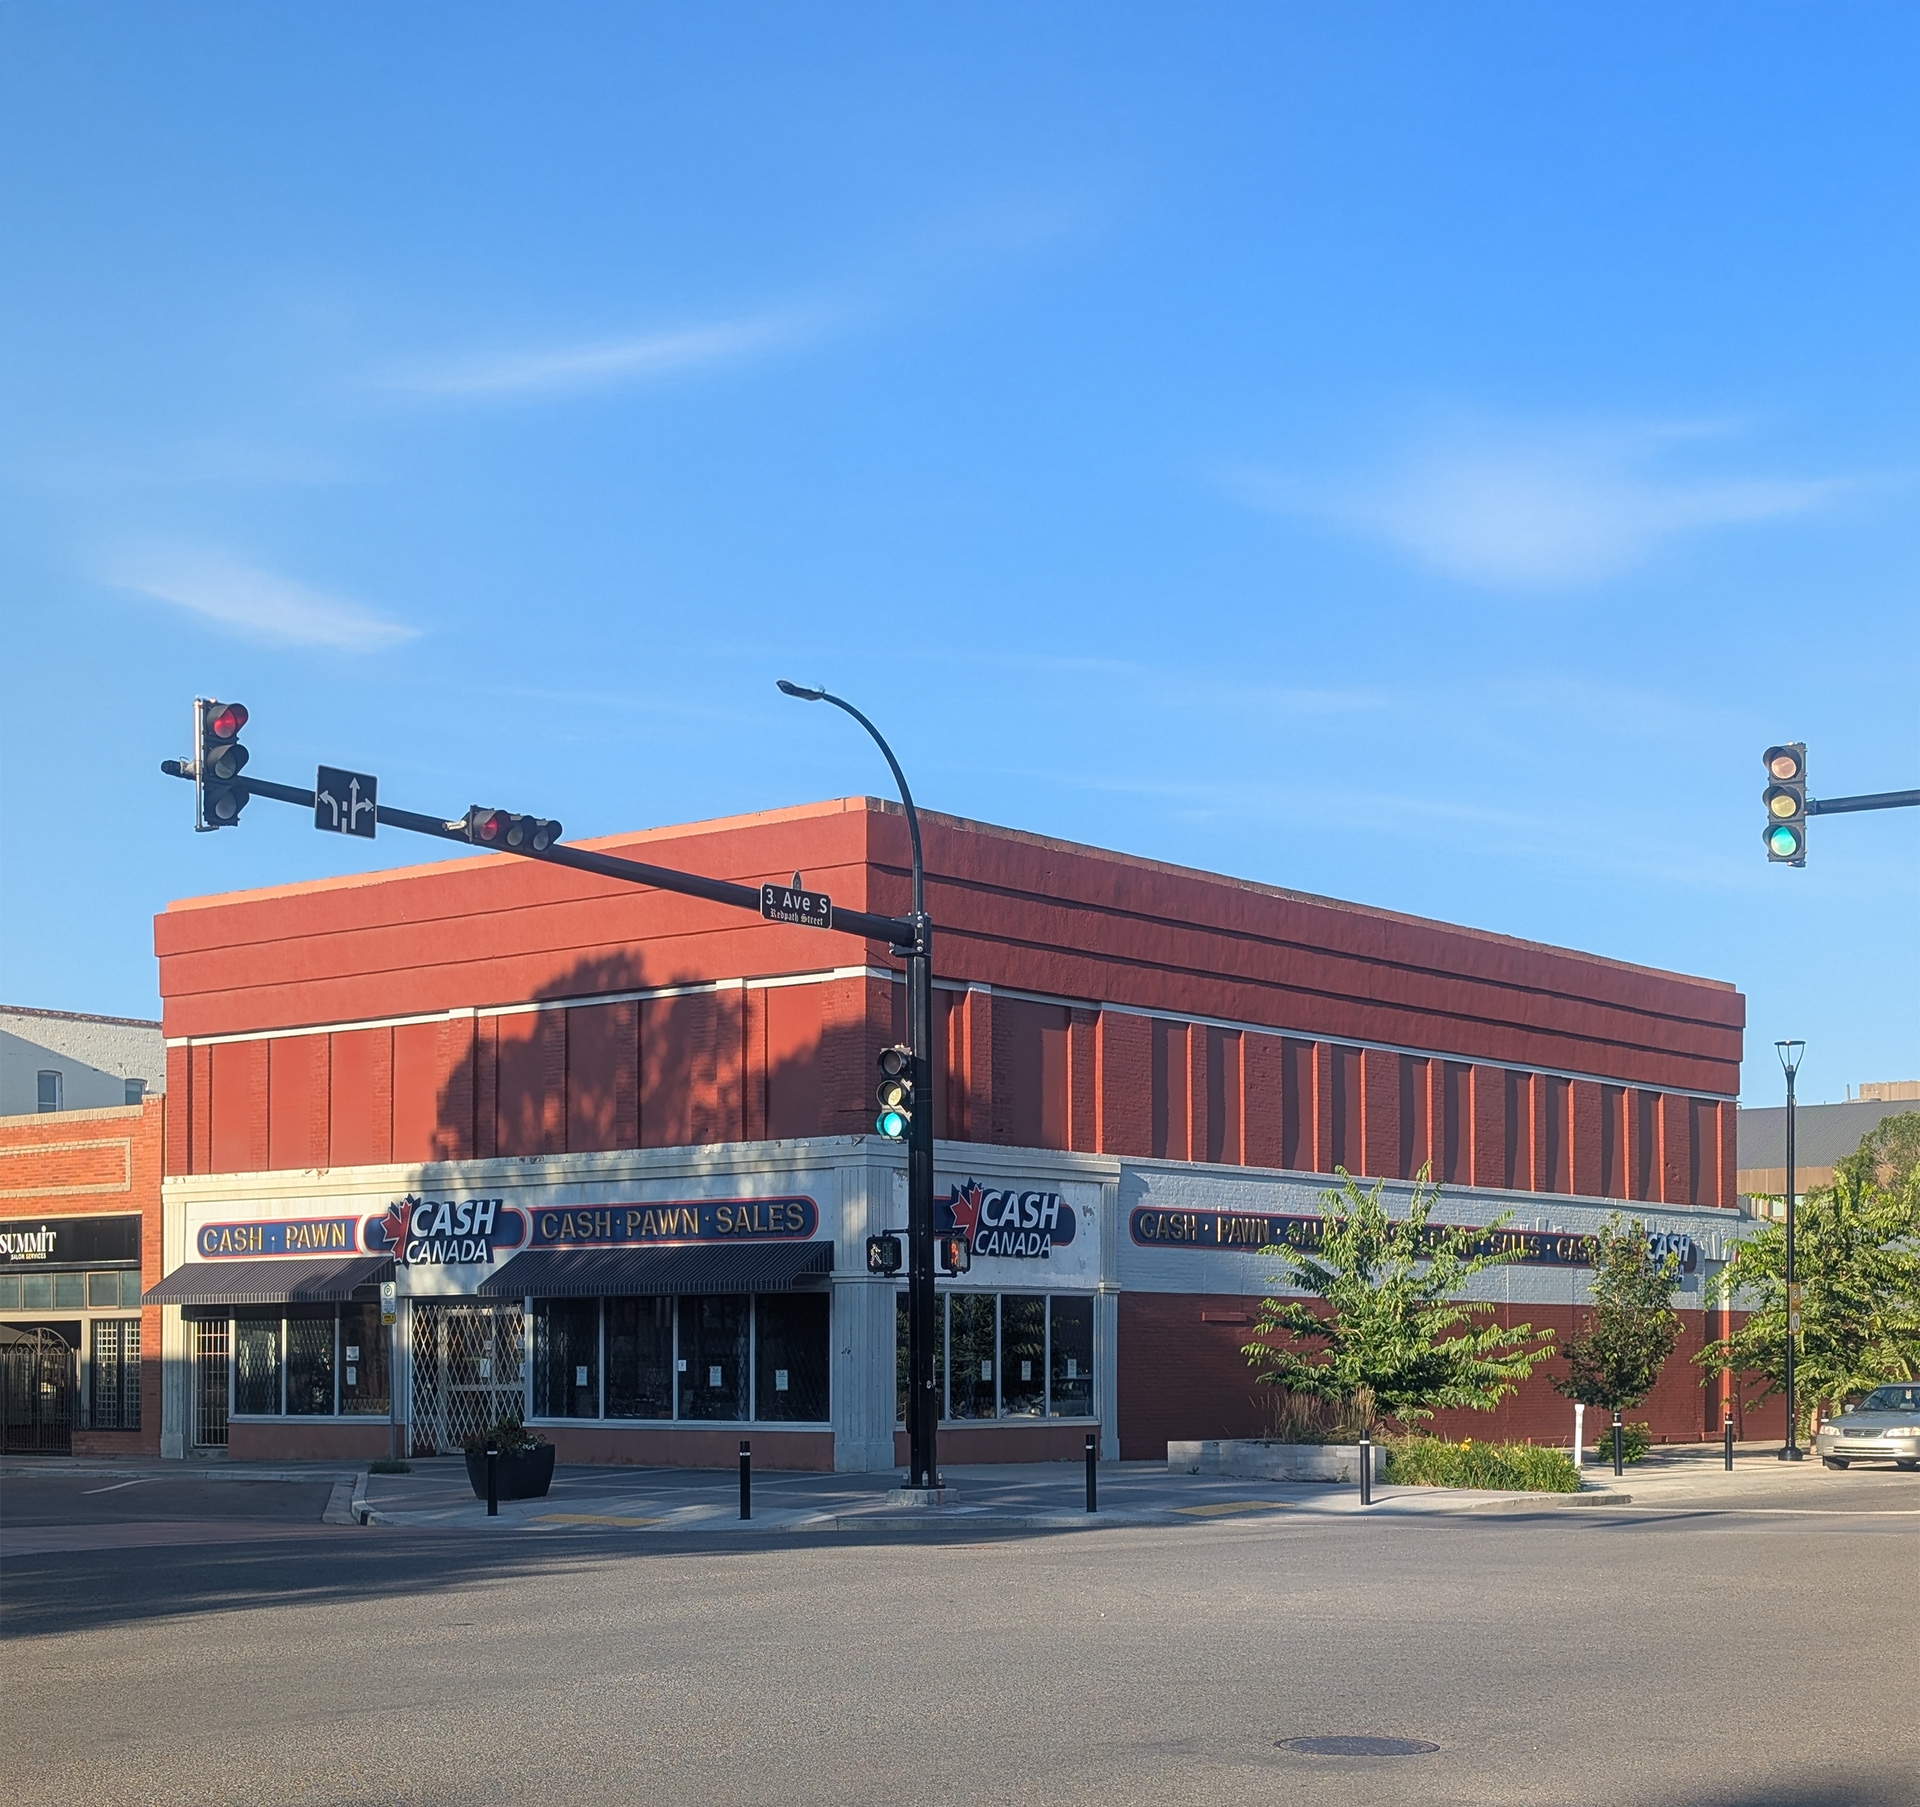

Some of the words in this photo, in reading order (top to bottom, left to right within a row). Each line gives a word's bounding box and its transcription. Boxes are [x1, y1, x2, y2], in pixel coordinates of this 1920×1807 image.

[770, 908, 799, 921] Redpath
[800, 913, 823, 925] Street
[783, 891, 811, 911] Ave
[820, 897, 828, 914] S
[410, 1201, 496, 1238] CASH
[540, 1210, 611, 1240] CASH
[626, 1207, 699, 1237] PAWN
[715, 1203, 804, 1234] SALES
[981, 1191, 1060, 1229] CASH
[203, 1226, 263, 1253] CASH
[286, 1222, 346, 1250] PAWN
[975, 1230, 1052, 1256] CANADA
[1140, 1212, 1198, 1241] CASH
[1216, 1216, 1270, 1244] PAWN
[405, 1239, 488, 1263] CANADA
